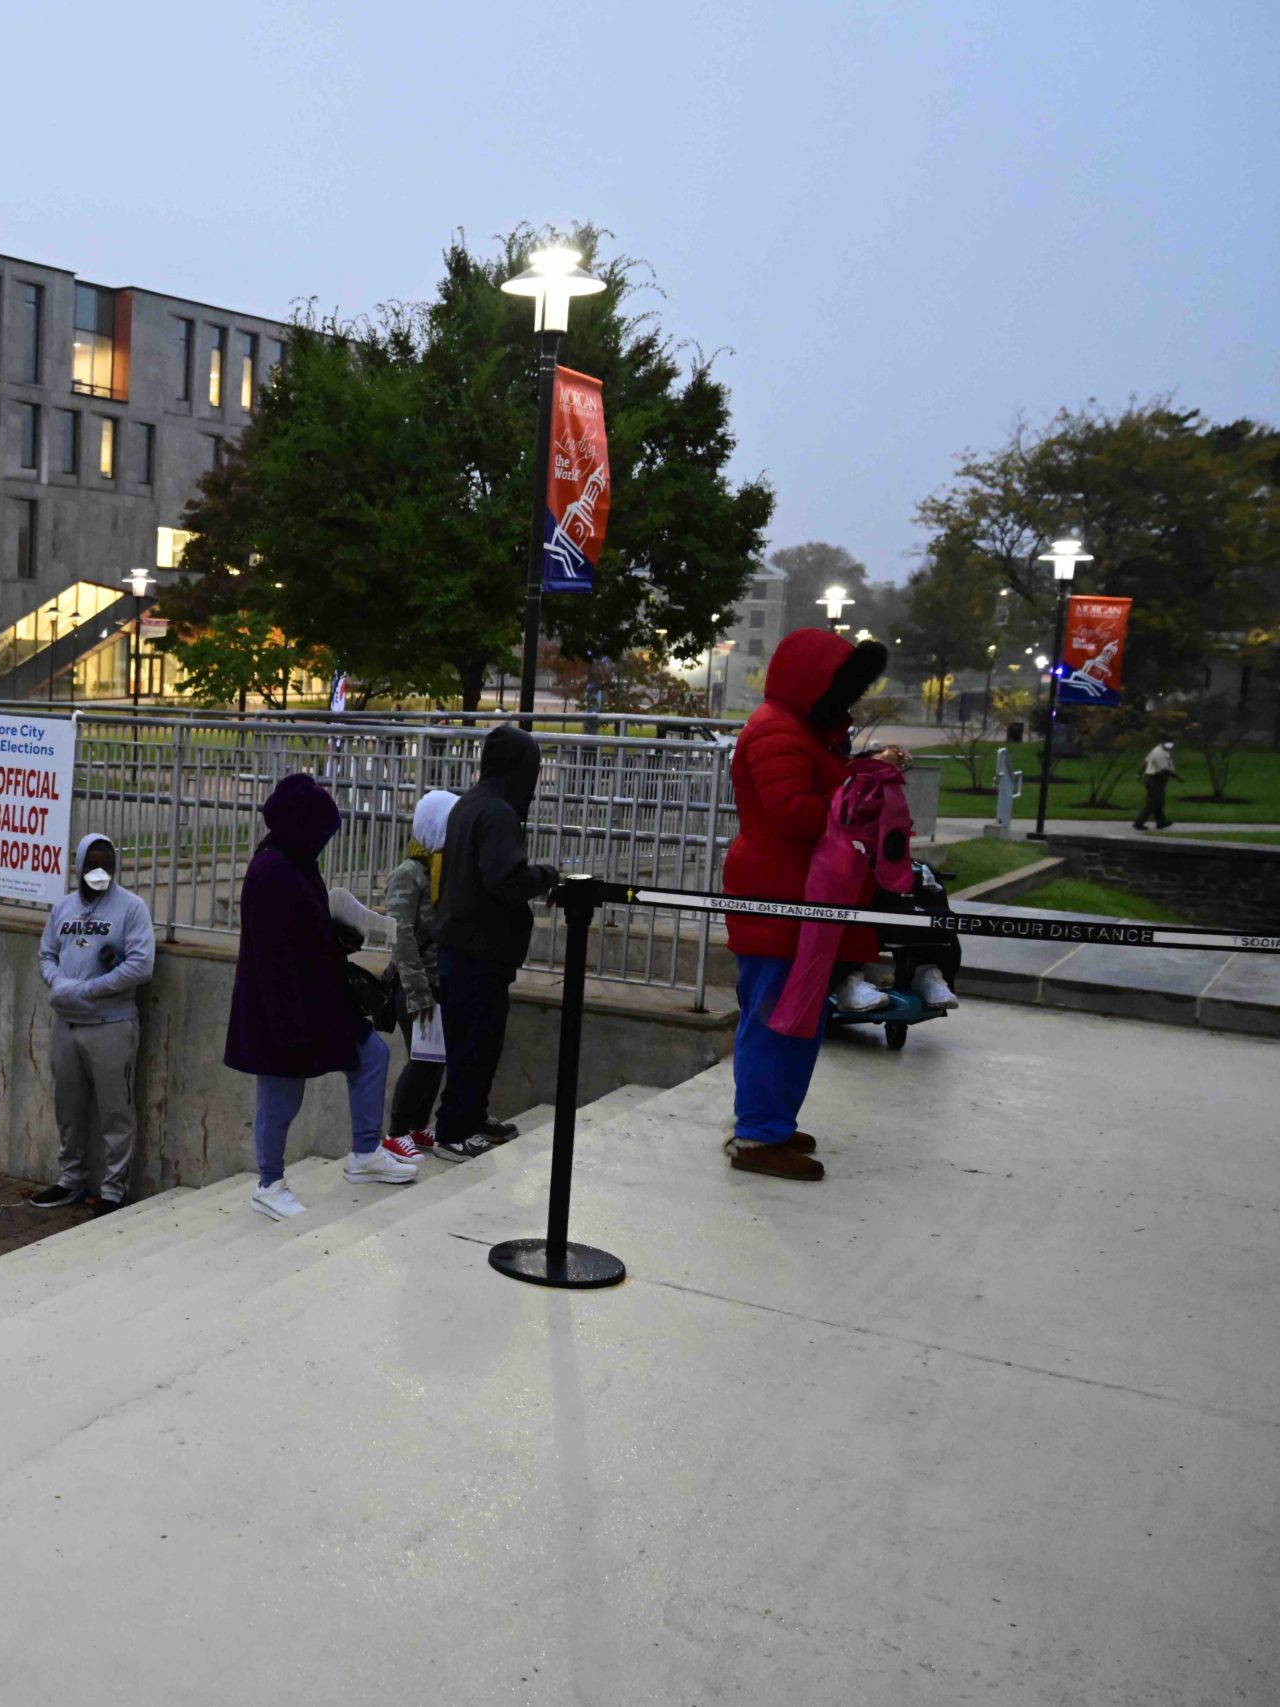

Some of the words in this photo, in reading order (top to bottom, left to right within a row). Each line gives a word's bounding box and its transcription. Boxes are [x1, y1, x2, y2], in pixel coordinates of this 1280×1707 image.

[559, 386, 598, 412] MORGAN
[555, 454, 570, 467] the
[555, 466, 580, 481] World
[20, 724, 45, 741] City
[0, 740, 55, 756] Elections
[31, 843, 62, 875] BOX
[711, 898, 754, 912] SOCIAL
[758, 902, 834, 919] DISTANCING
[60, 919, 112, 937] RAVENS
[932, 915, 982, 931] KEEP
[988, 918, 1044, 936] YOUR
[1049, 923, 1154, 943] DISTANCE
